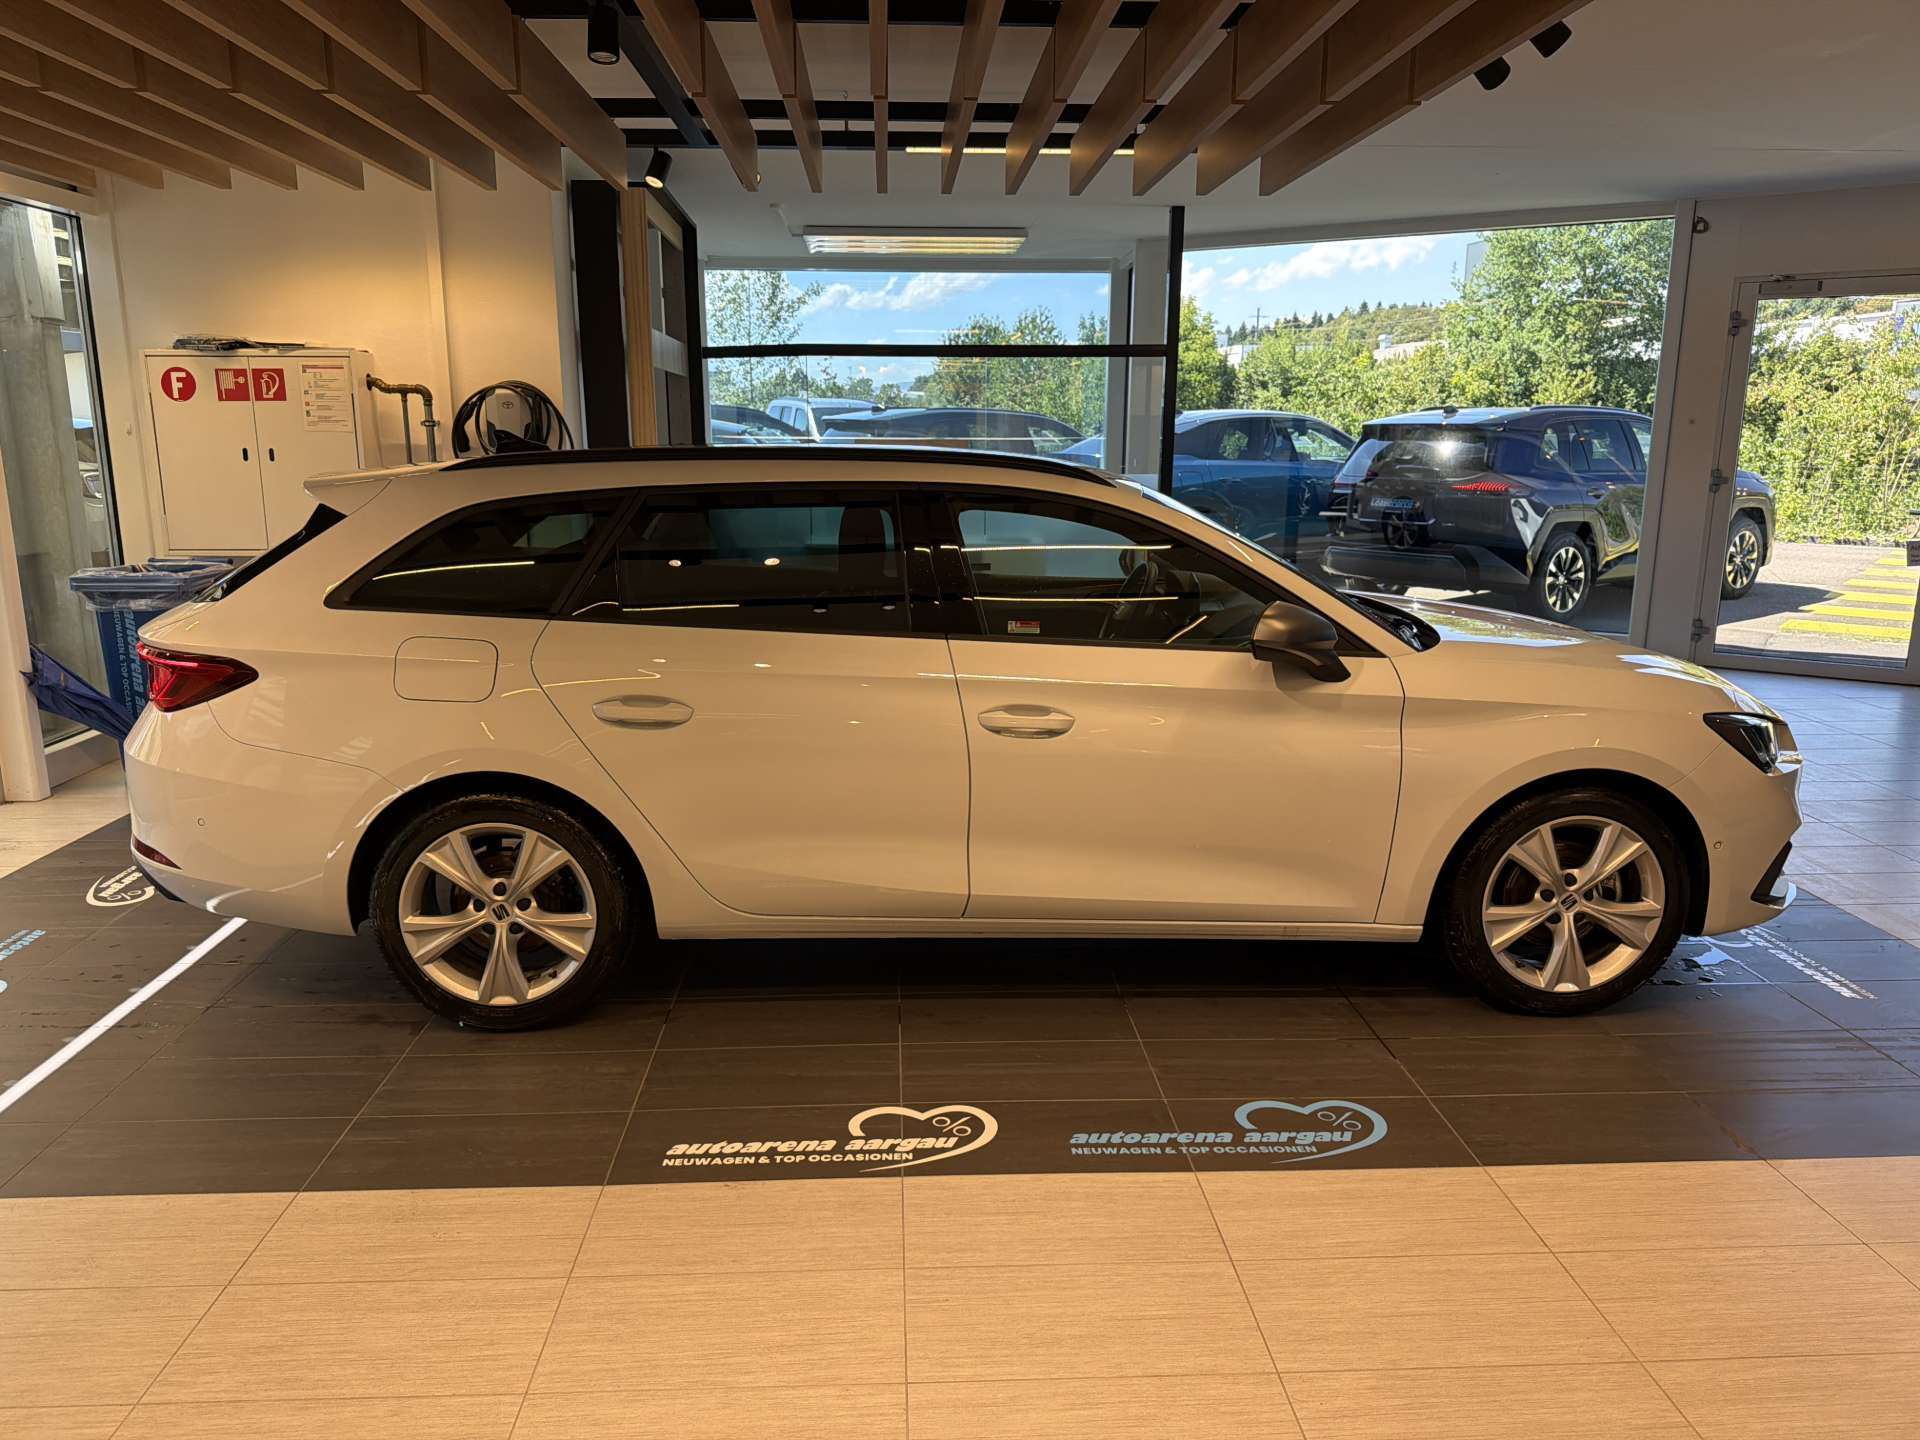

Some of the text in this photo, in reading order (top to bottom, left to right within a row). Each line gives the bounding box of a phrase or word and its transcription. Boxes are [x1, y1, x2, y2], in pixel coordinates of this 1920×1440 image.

[170, 371, 187, 399] F
[1070, 1131, 1352, 1144] autoarena aargau
[666, 1136, 959, 1155] autoarena aargau
[1071, 1145, 1318, 1155] NEUWAGEN & TOP OCCASIONEN
[662, 1152, 913, 1167] NEUWAGEN & TOP OCCASIONEN
